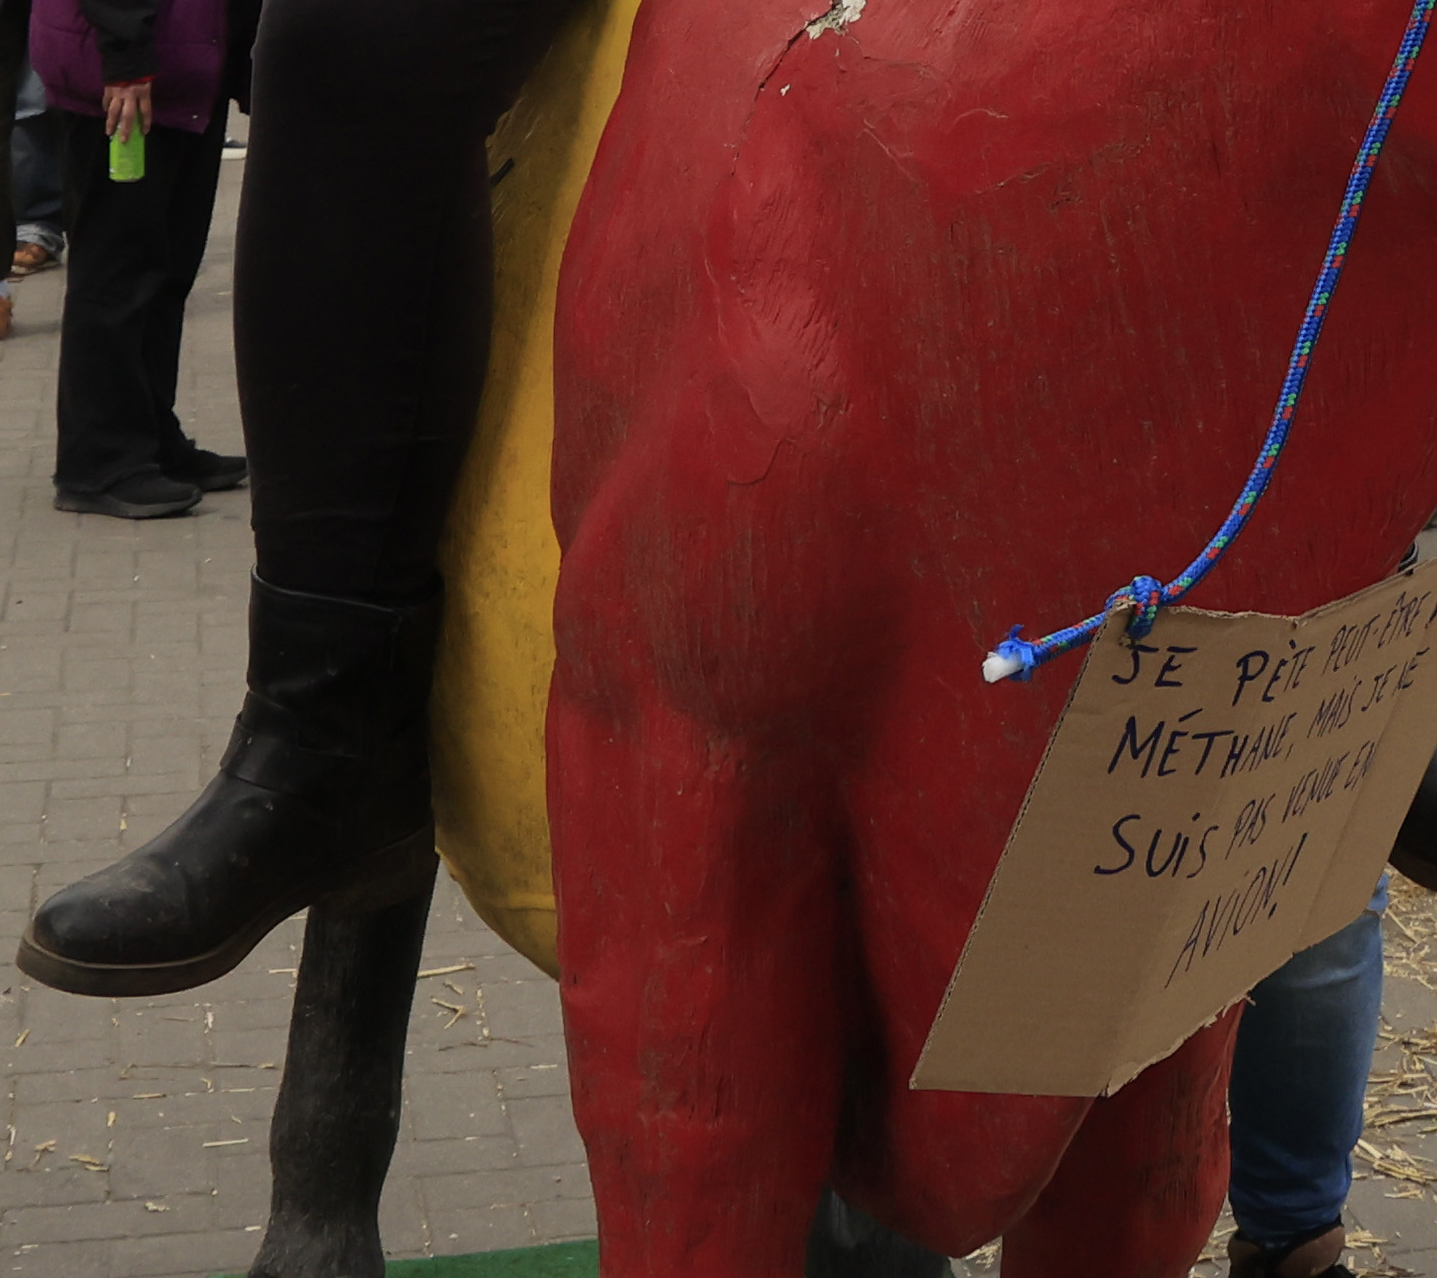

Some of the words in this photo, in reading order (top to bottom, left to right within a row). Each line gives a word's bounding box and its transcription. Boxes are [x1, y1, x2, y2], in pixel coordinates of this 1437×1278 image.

[1112, 646, 1198, 687] JE
[1361, 664, 1398, 713] JE
[1224, 793, 1276, 860] PAS
